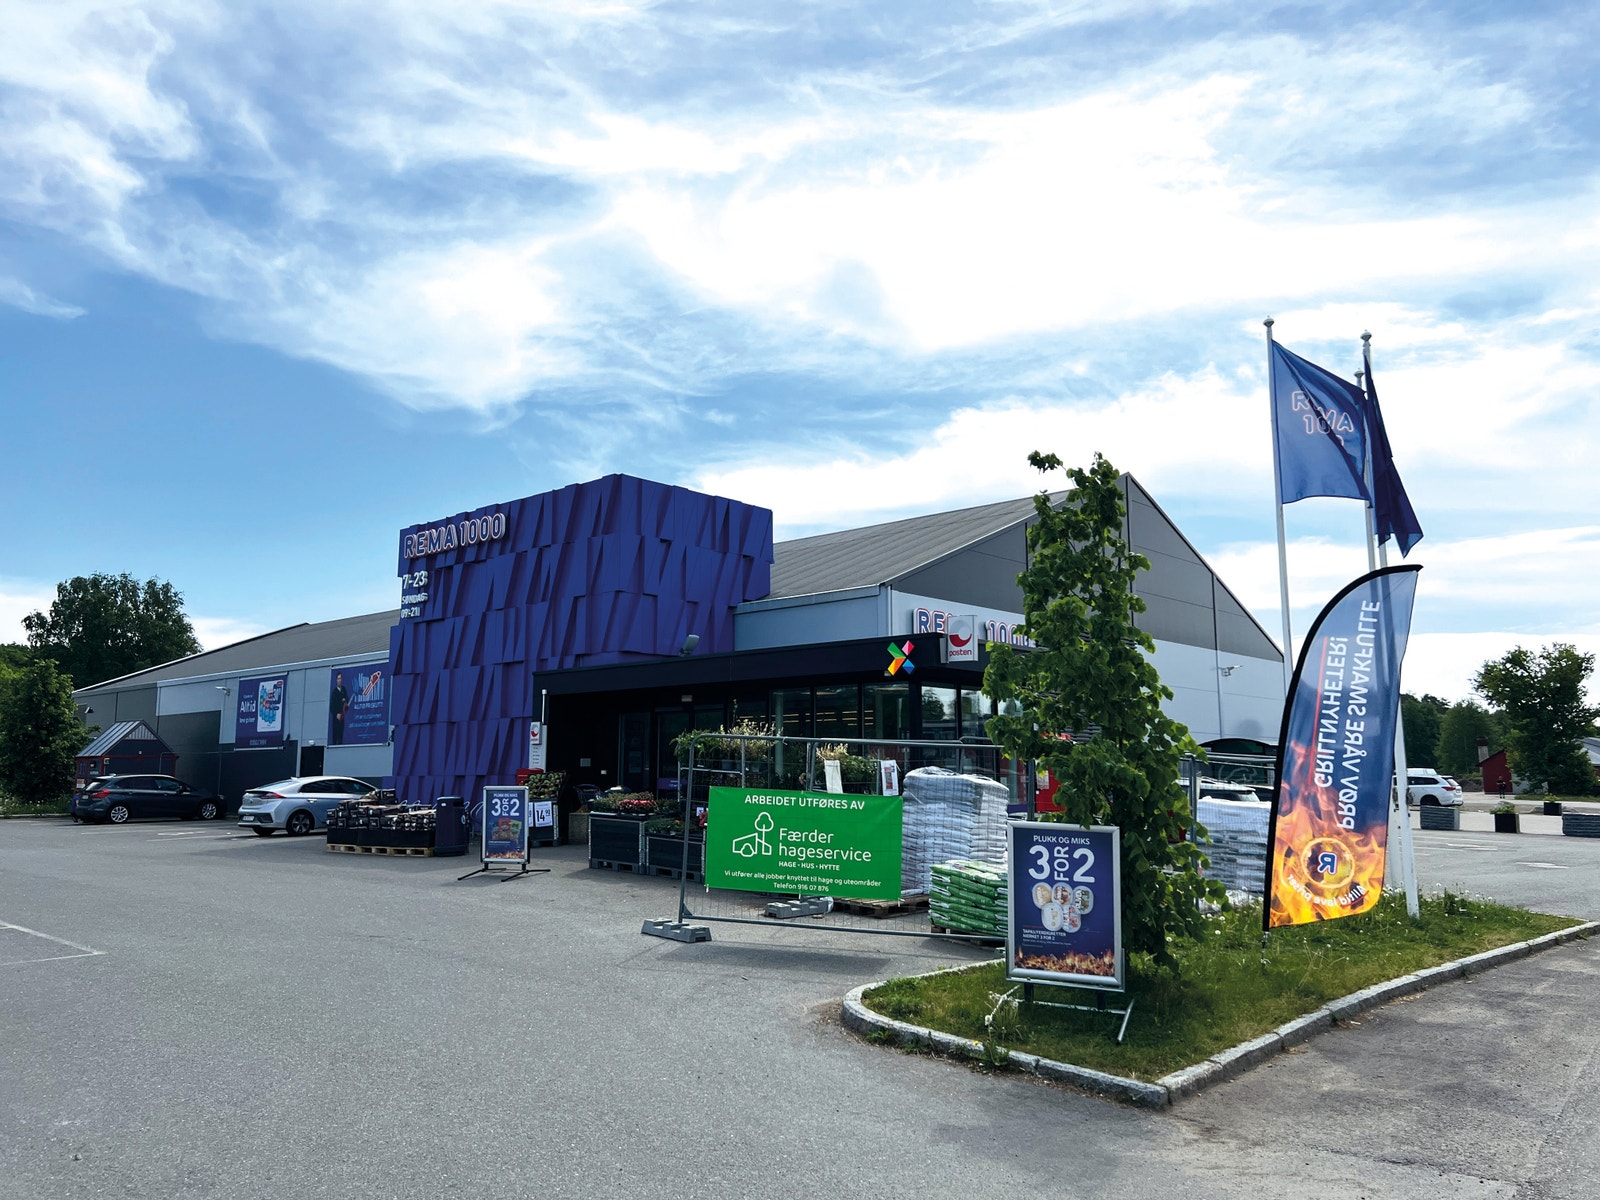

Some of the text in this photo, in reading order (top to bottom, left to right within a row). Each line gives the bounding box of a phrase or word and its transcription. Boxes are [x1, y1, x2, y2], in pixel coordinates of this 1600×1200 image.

[1292, 391, 1354, 433] RMA
[404, 514, 506, 558] REMA 1000
[402, 571, 428, 589] 7-23
[949, 648, 973, 657] posten
[491, 798, 502, 816] 3
[502, 798, 510, 816] FOR
[510, 798, 520, 816] 2
[745, 795, 865, 810] ARBEIDET UTFØRES AV
[536, 810, 546, 822] 14
[779, 828, 834, 844] Færder
[1033, 835, 1091, 845] PLUKK OG MIKS
[778, 843, 872, 862] hageservice
[1028, 845, 1096, 883] 3 FOR 2
[765, 873, 786, 881] jobber
[786, 874, 810, 882] knyttet
[817, 877, 833, 885] hage
[843, 879, 882, 887] uteområder
